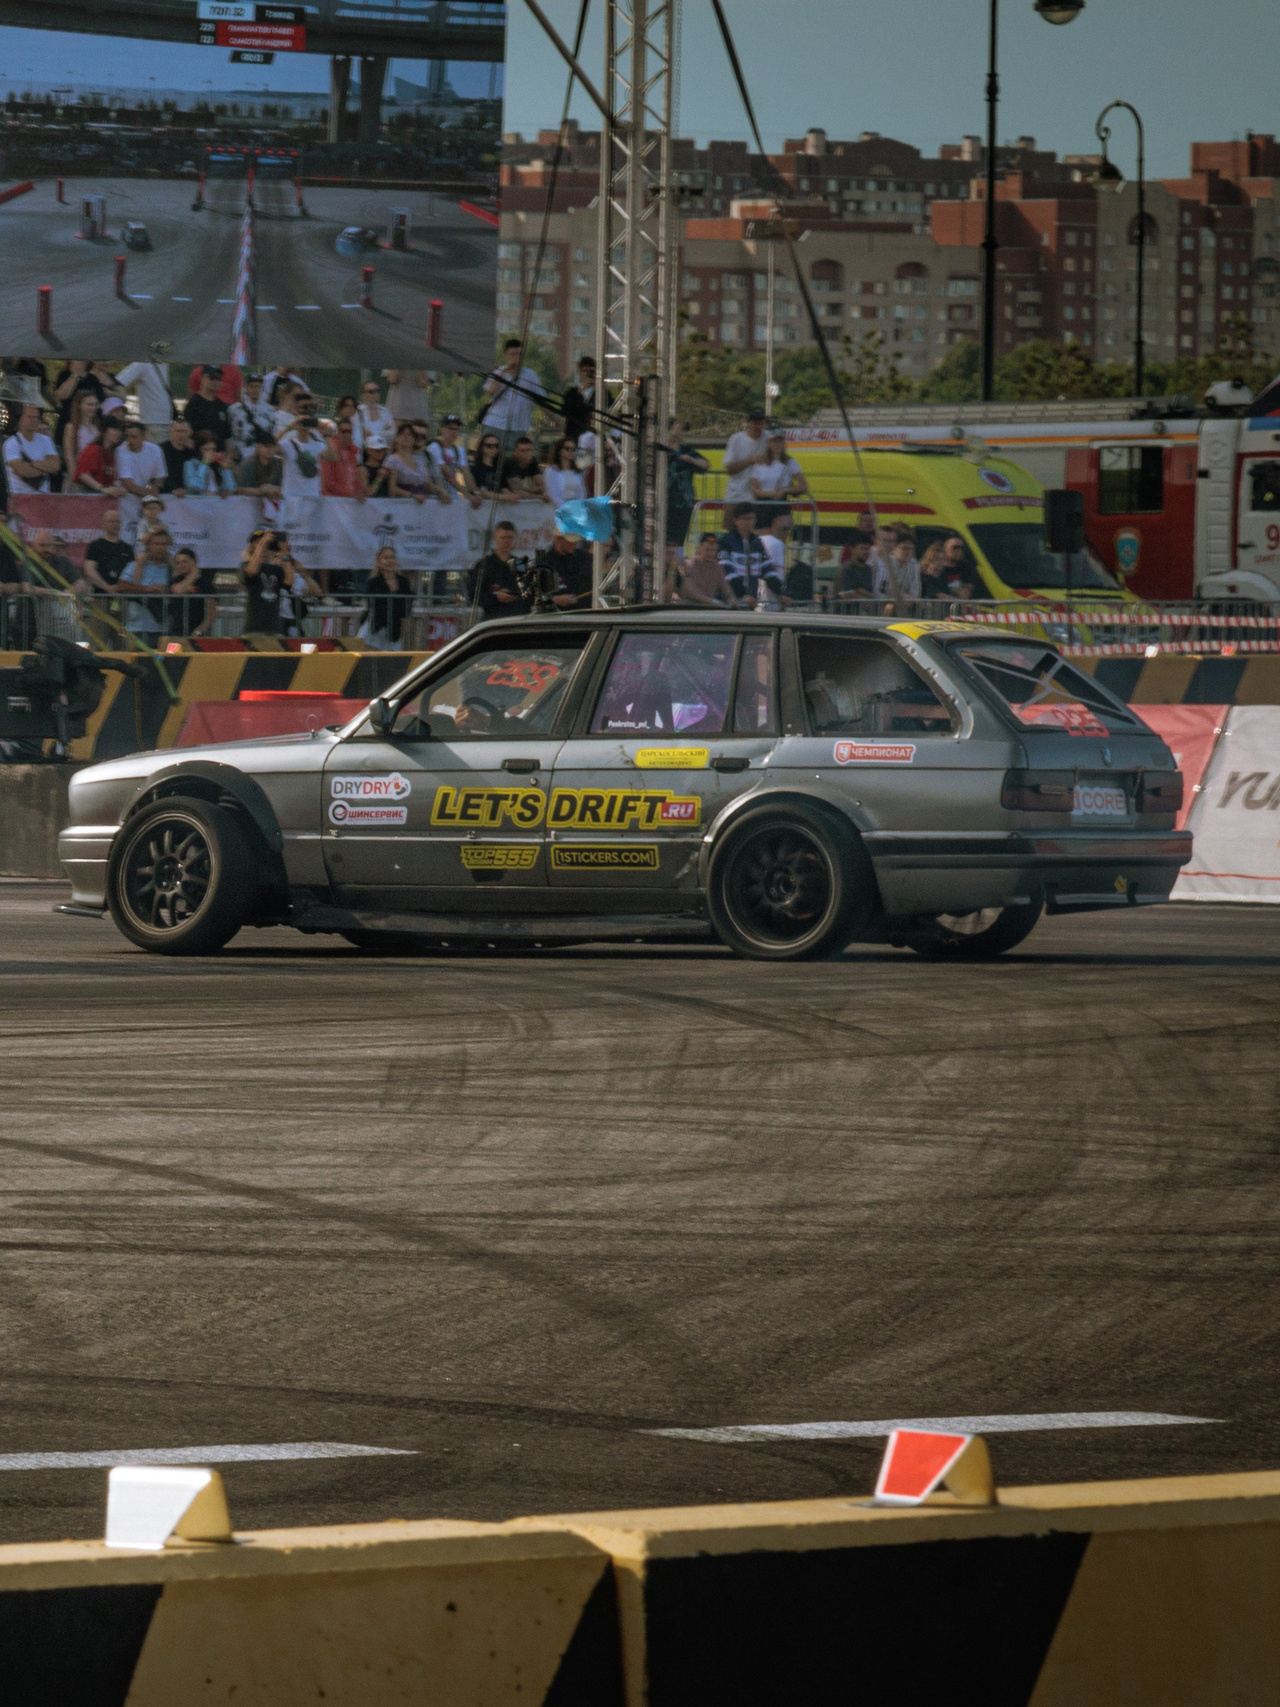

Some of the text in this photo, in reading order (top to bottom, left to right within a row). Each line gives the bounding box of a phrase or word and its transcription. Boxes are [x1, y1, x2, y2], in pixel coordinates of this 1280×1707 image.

[851, 747, 912, 757] ЧЕМПИОНАТ
[436, 792, 540, 822] LET'S
[348, 810, 404, 818] ШИНСЕРВИС
